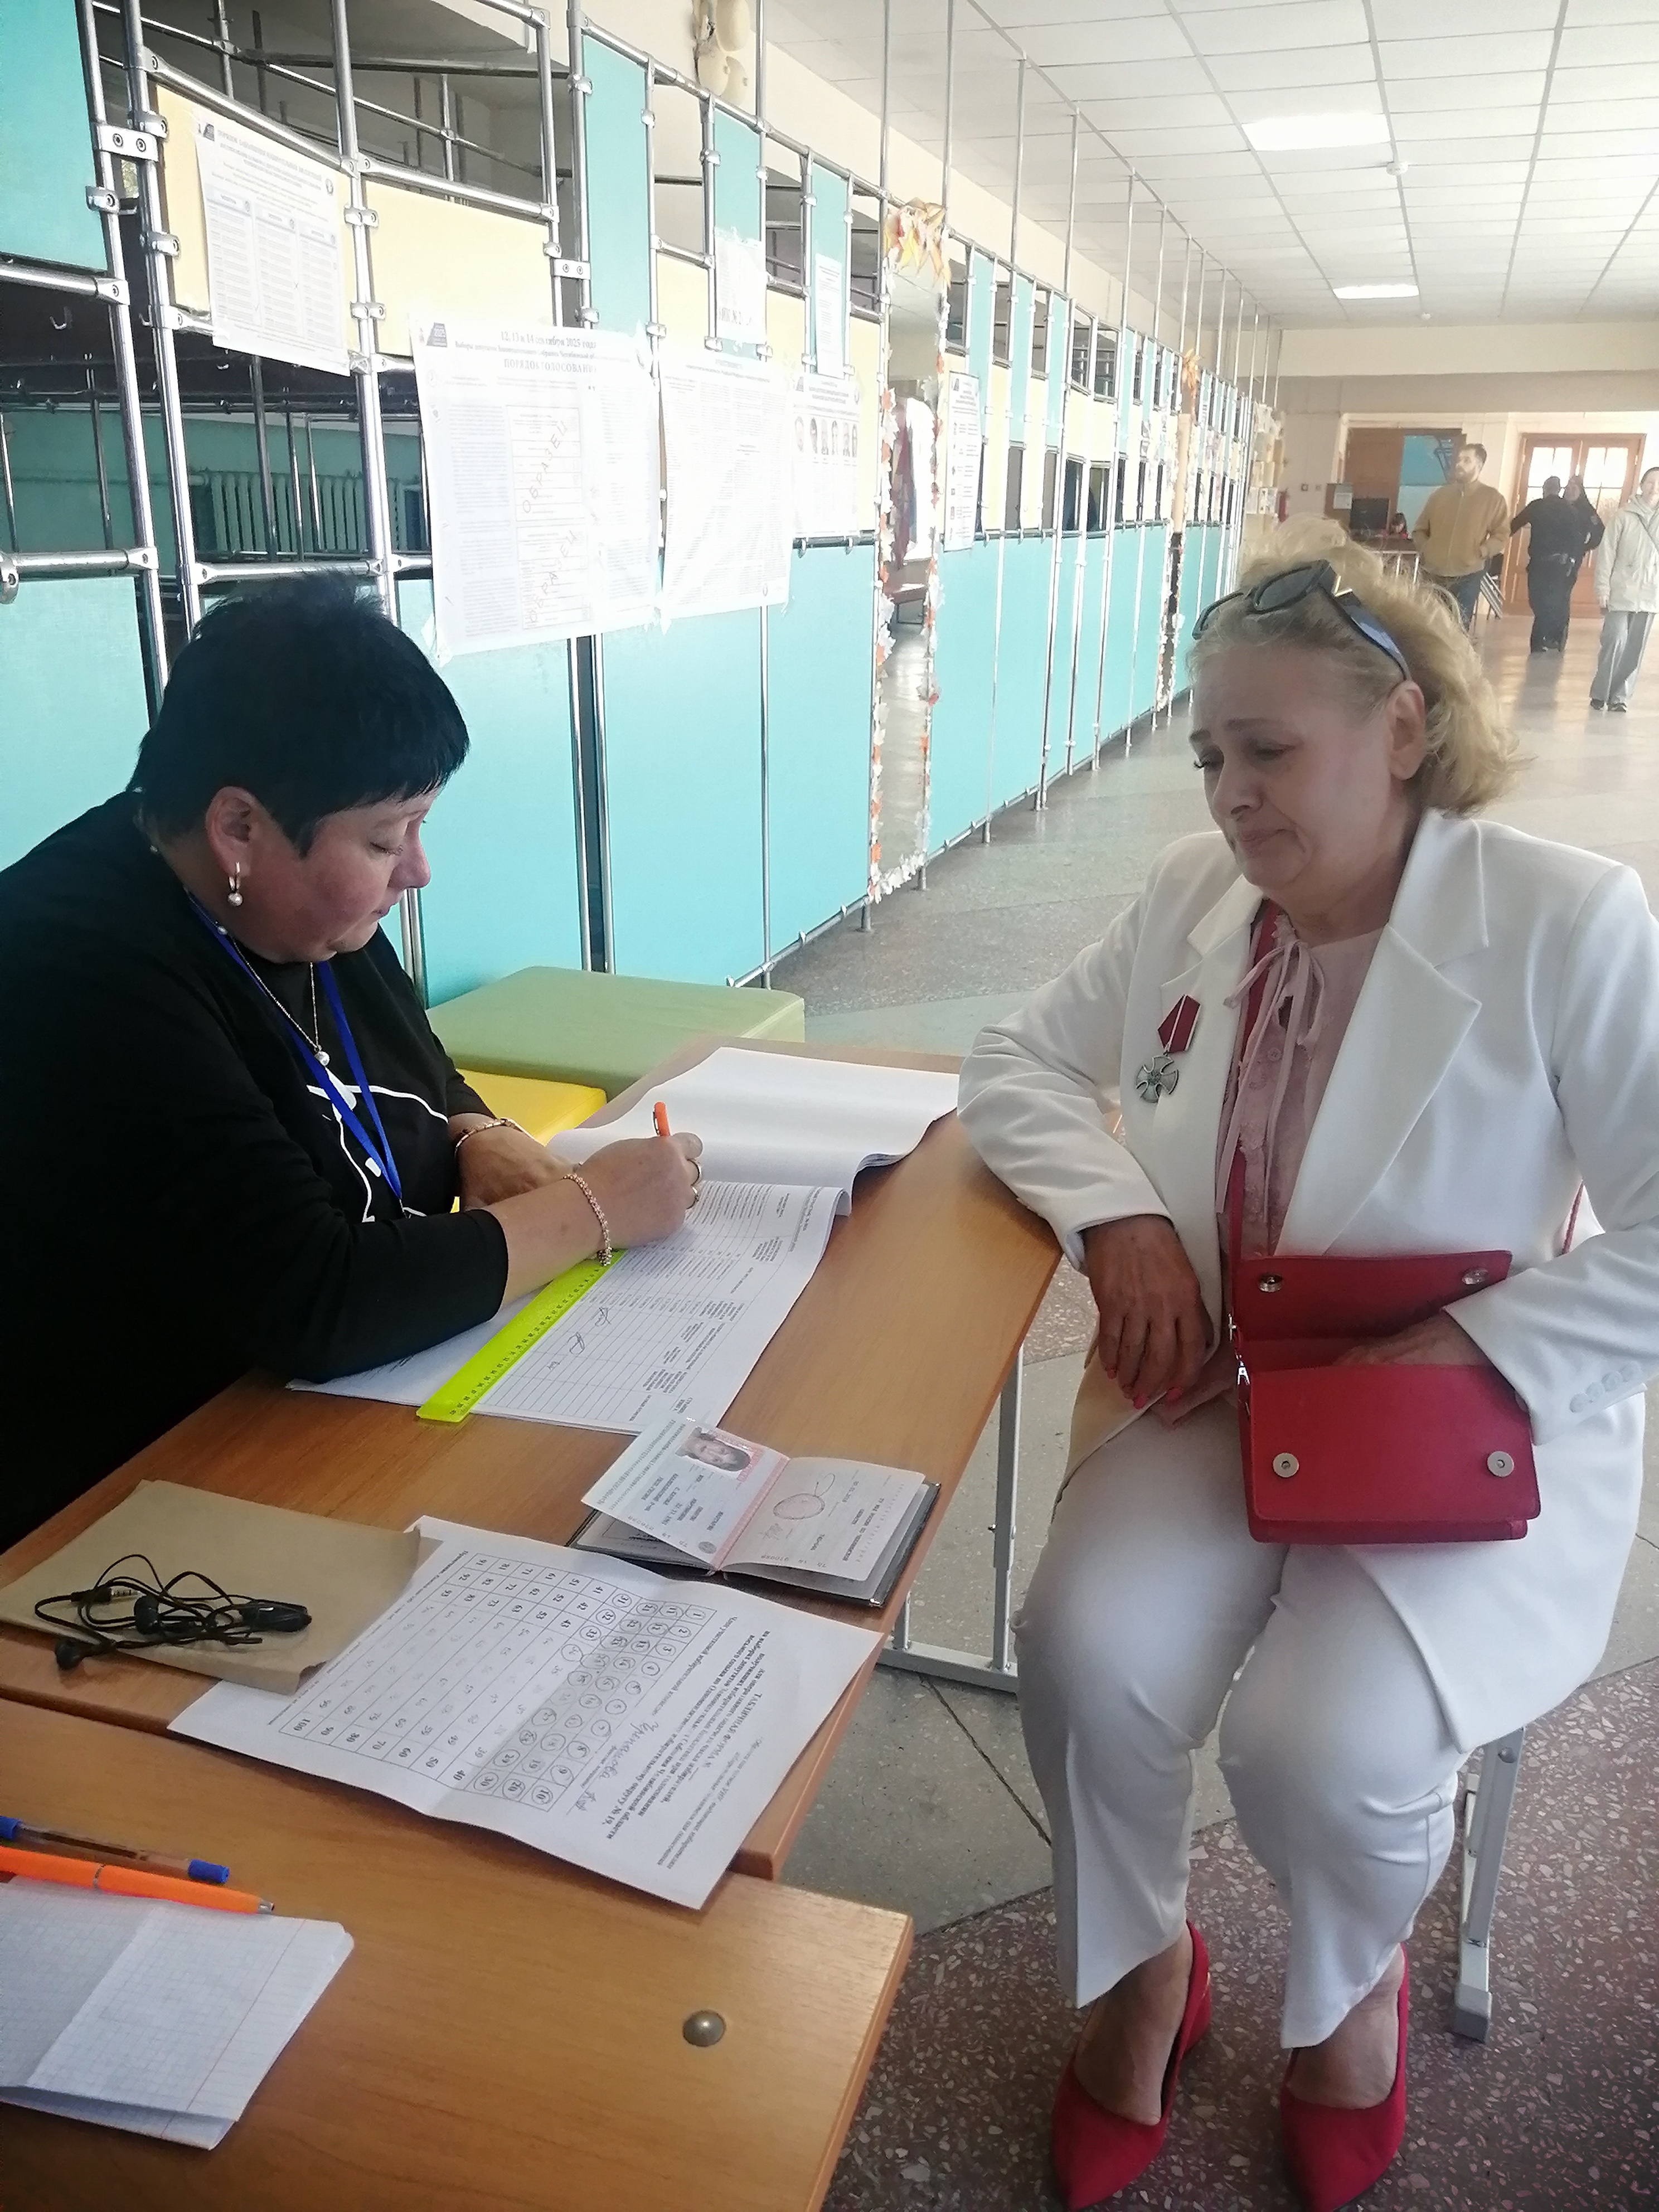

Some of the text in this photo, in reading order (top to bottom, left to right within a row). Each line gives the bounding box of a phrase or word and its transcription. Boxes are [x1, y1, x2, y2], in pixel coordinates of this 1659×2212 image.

[526, 333, 533, 344] 14
[566, 337, 581, 348] 2025
[536, 1611, 547, 1619] 53
[586, 1629, 597, 1638] 33
[294, 1719, 310, 1730] 100
[321, 1727, 334, 1735] 90
[347, 1733, 360, 1742] 80
[399, 1748, 411, 1757] 60
[426, 1757, 438, 1768] 50
[529, 1760, 541, 1768] 19
[453, 1770, 465, 1781] 40
[480, 1777, 493, 1786] 30
[508, 1782, 521, 1791] 20
[536, 1790, 551, 1799] 10
